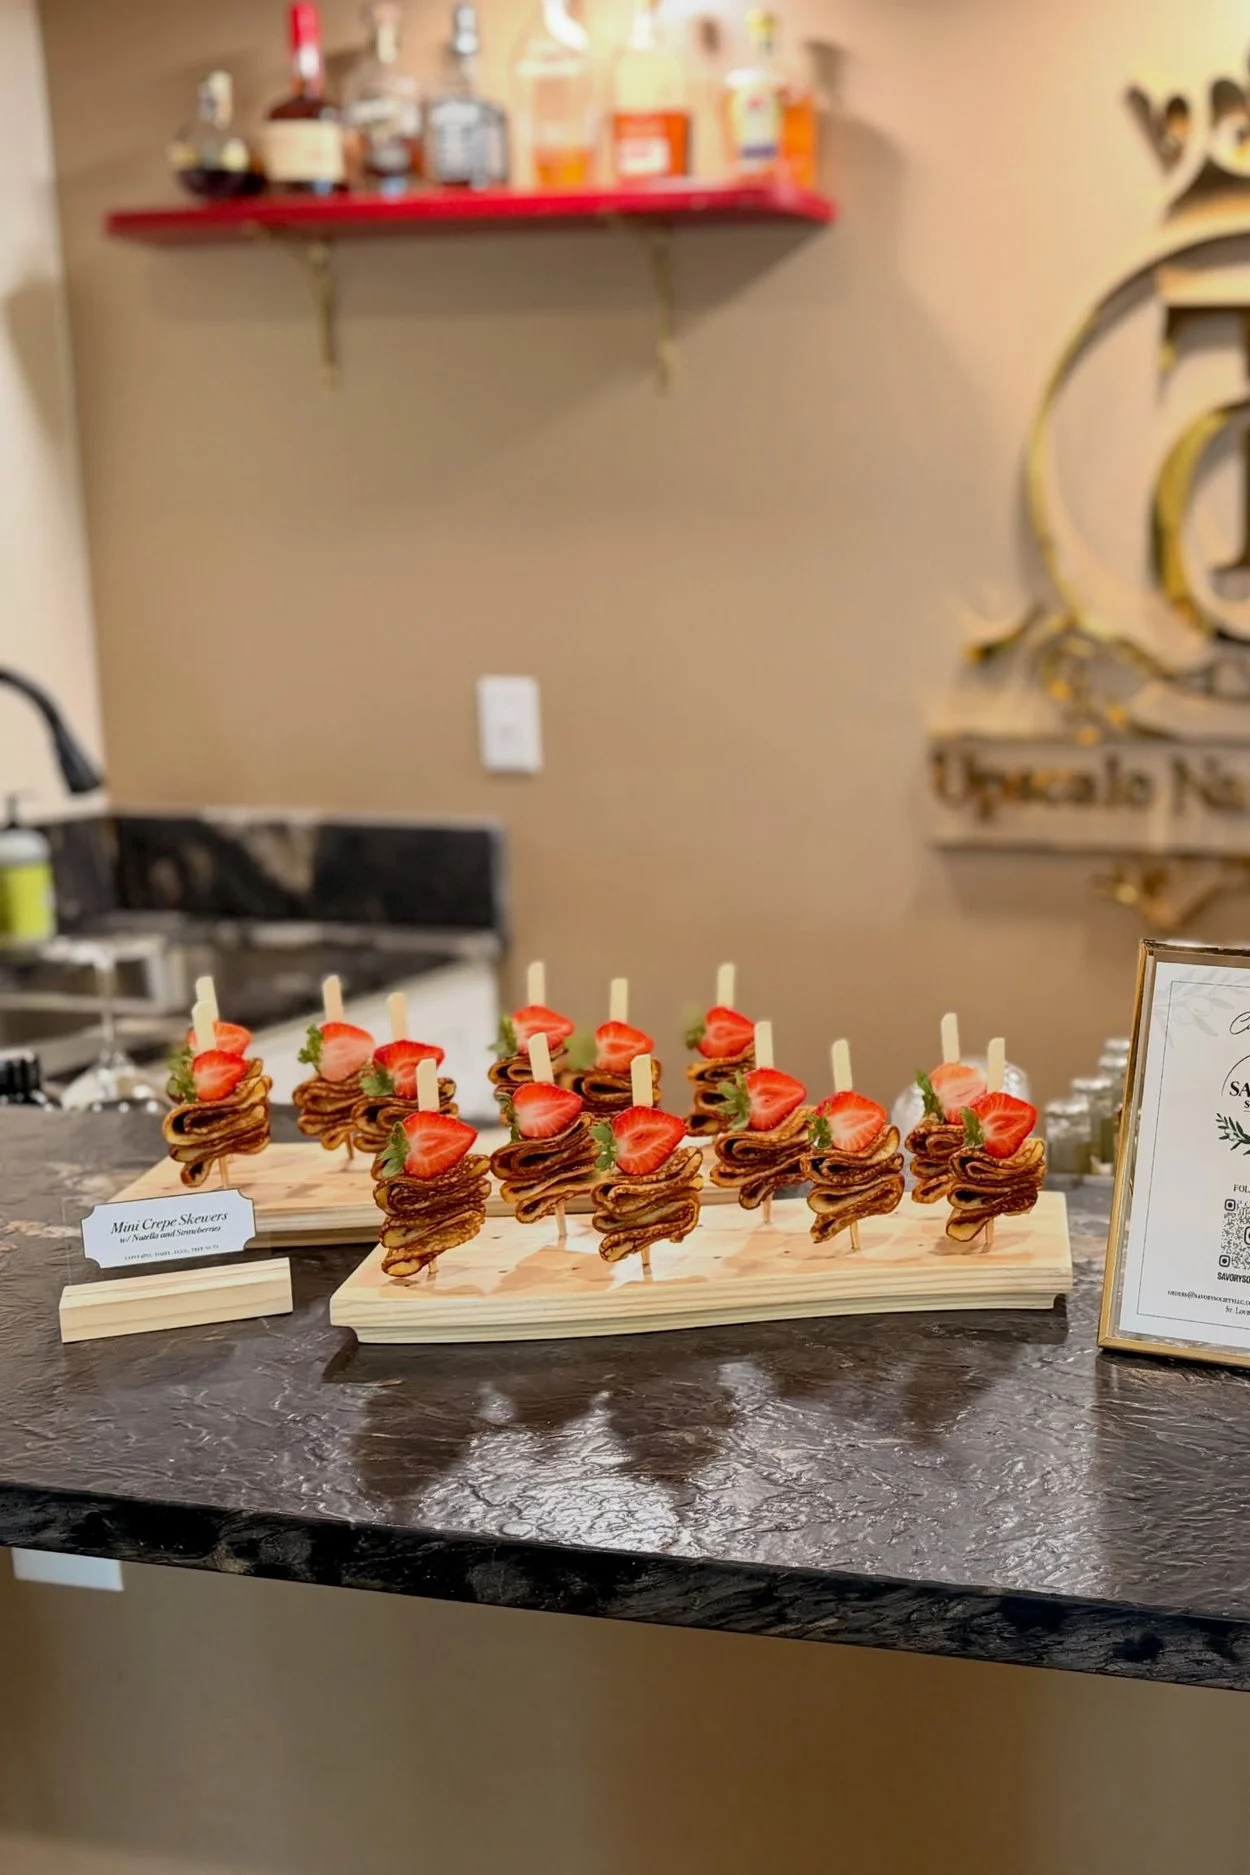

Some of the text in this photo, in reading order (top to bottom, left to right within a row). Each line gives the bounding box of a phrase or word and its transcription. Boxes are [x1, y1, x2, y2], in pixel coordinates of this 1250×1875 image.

[111, 1212, 228, 1234] Mini Crepe Skewers
